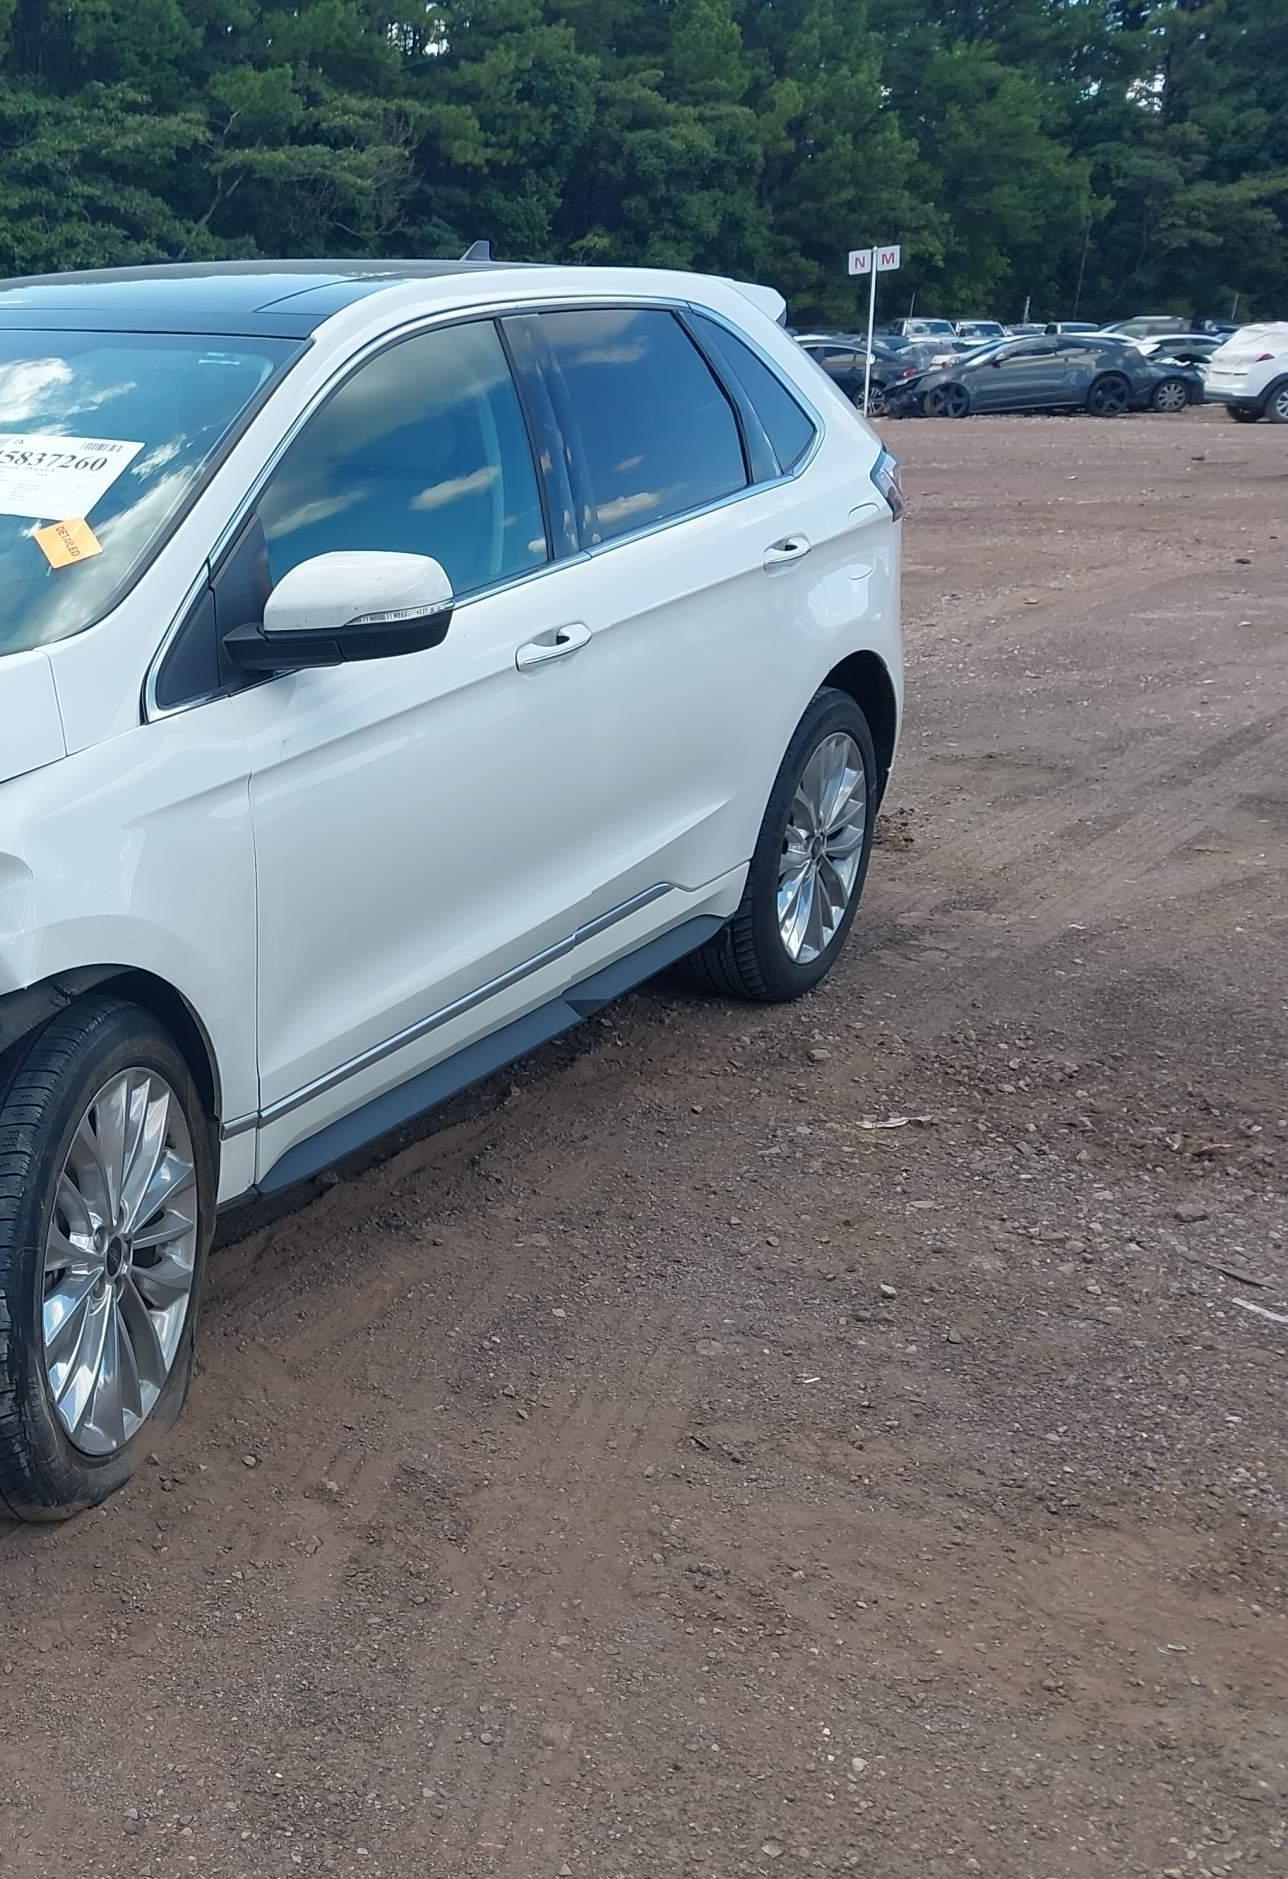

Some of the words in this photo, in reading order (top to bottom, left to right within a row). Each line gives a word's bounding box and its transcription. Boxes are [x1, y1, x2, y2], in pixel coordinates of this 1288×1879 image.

[854, 256, 866, 269] N
[881, 252, 895, 265] M
[55, 525, 81, 557] DETAILED
